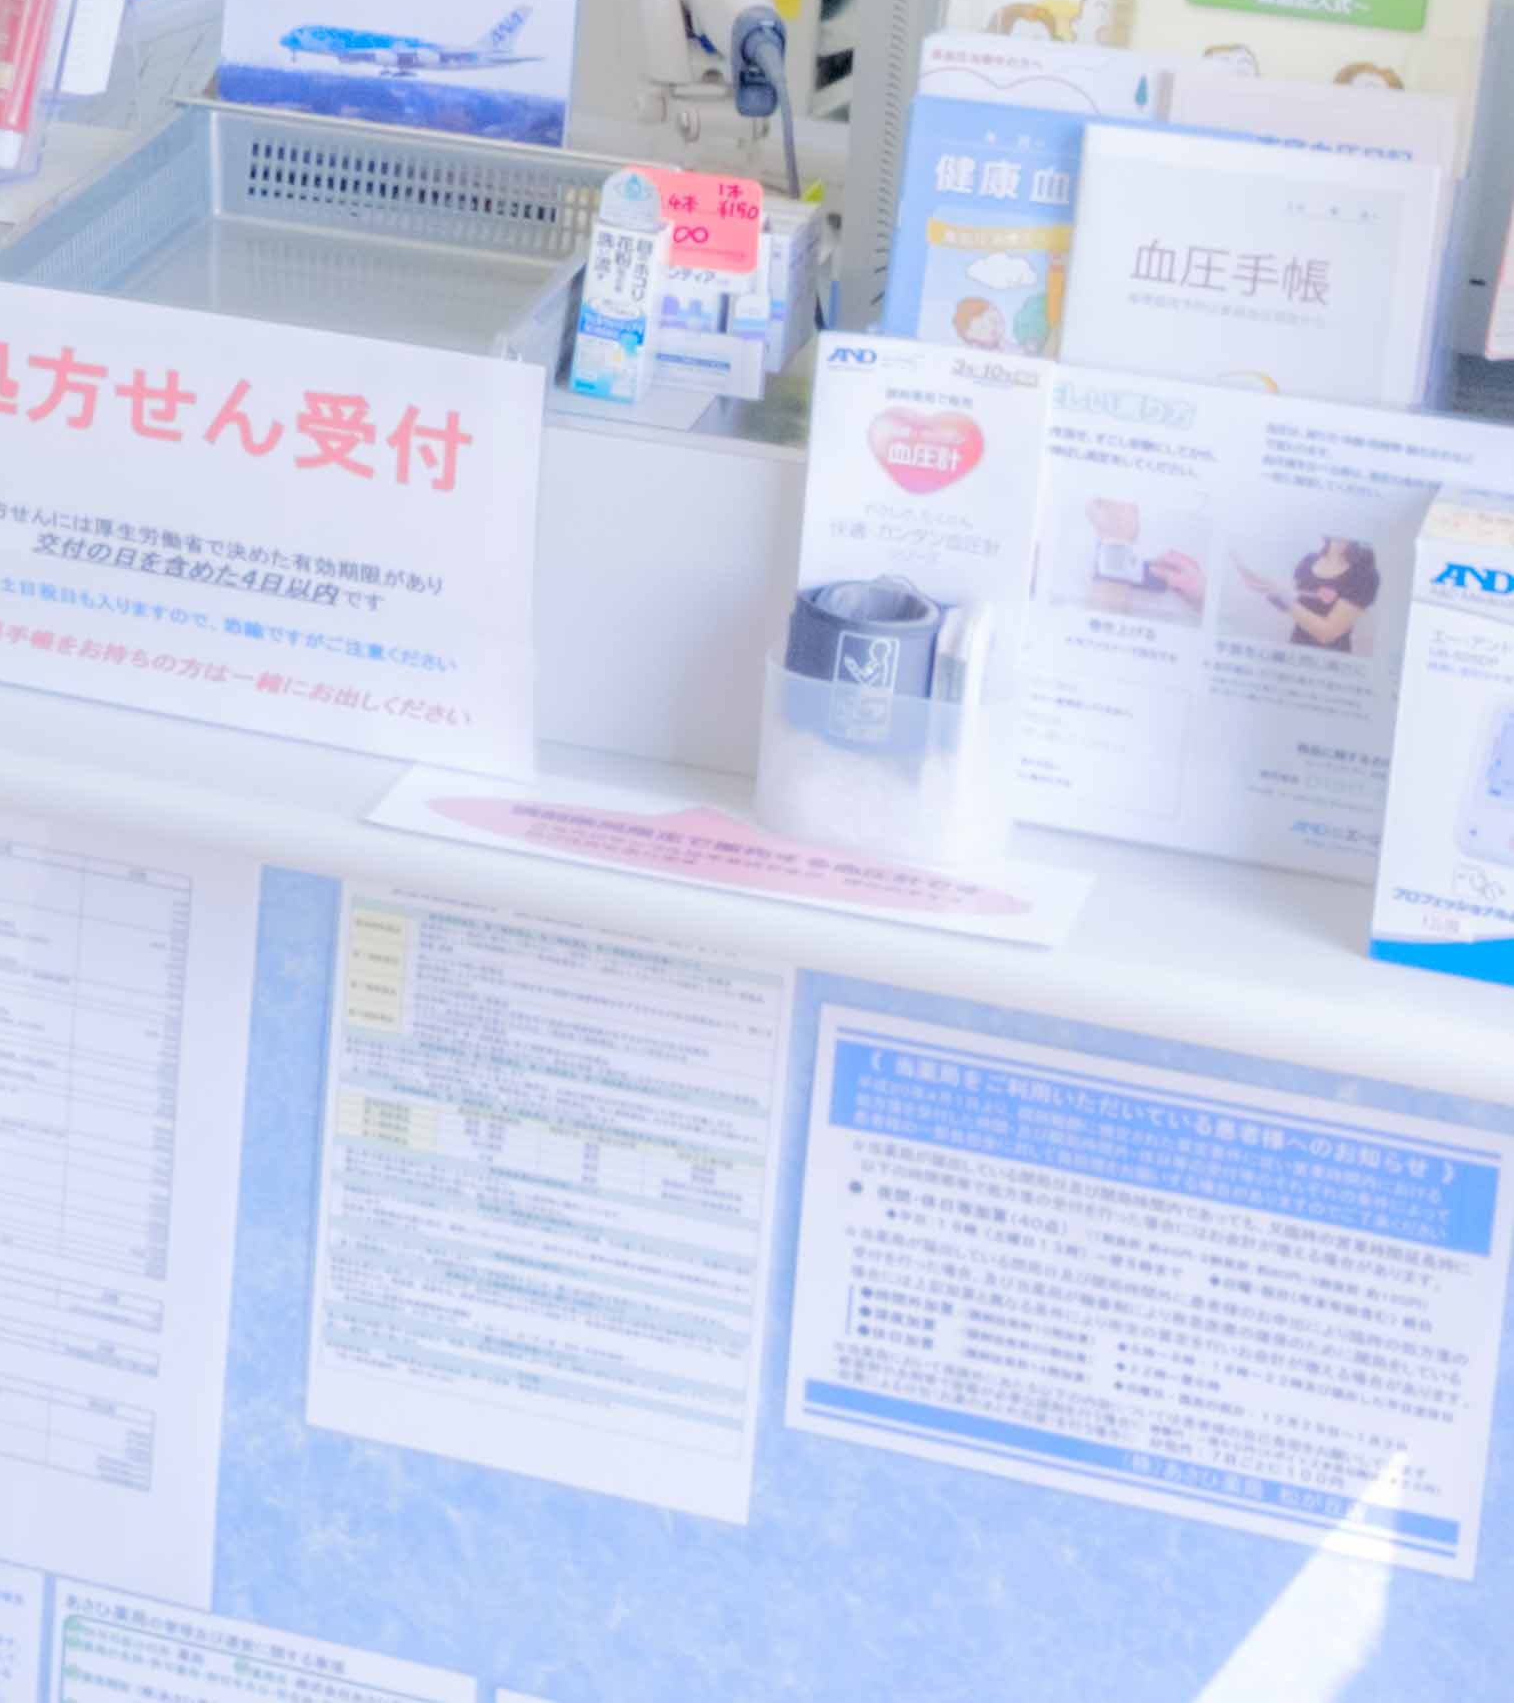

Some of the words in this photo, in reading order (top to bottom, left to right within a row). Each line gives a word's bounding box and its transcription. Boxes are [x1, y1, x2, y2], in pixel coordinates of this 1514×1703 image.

[1129, 238, 1333, 307] 血圧手帳
[31, 530, 387, 614] 交付の日を含めた4日以内です
